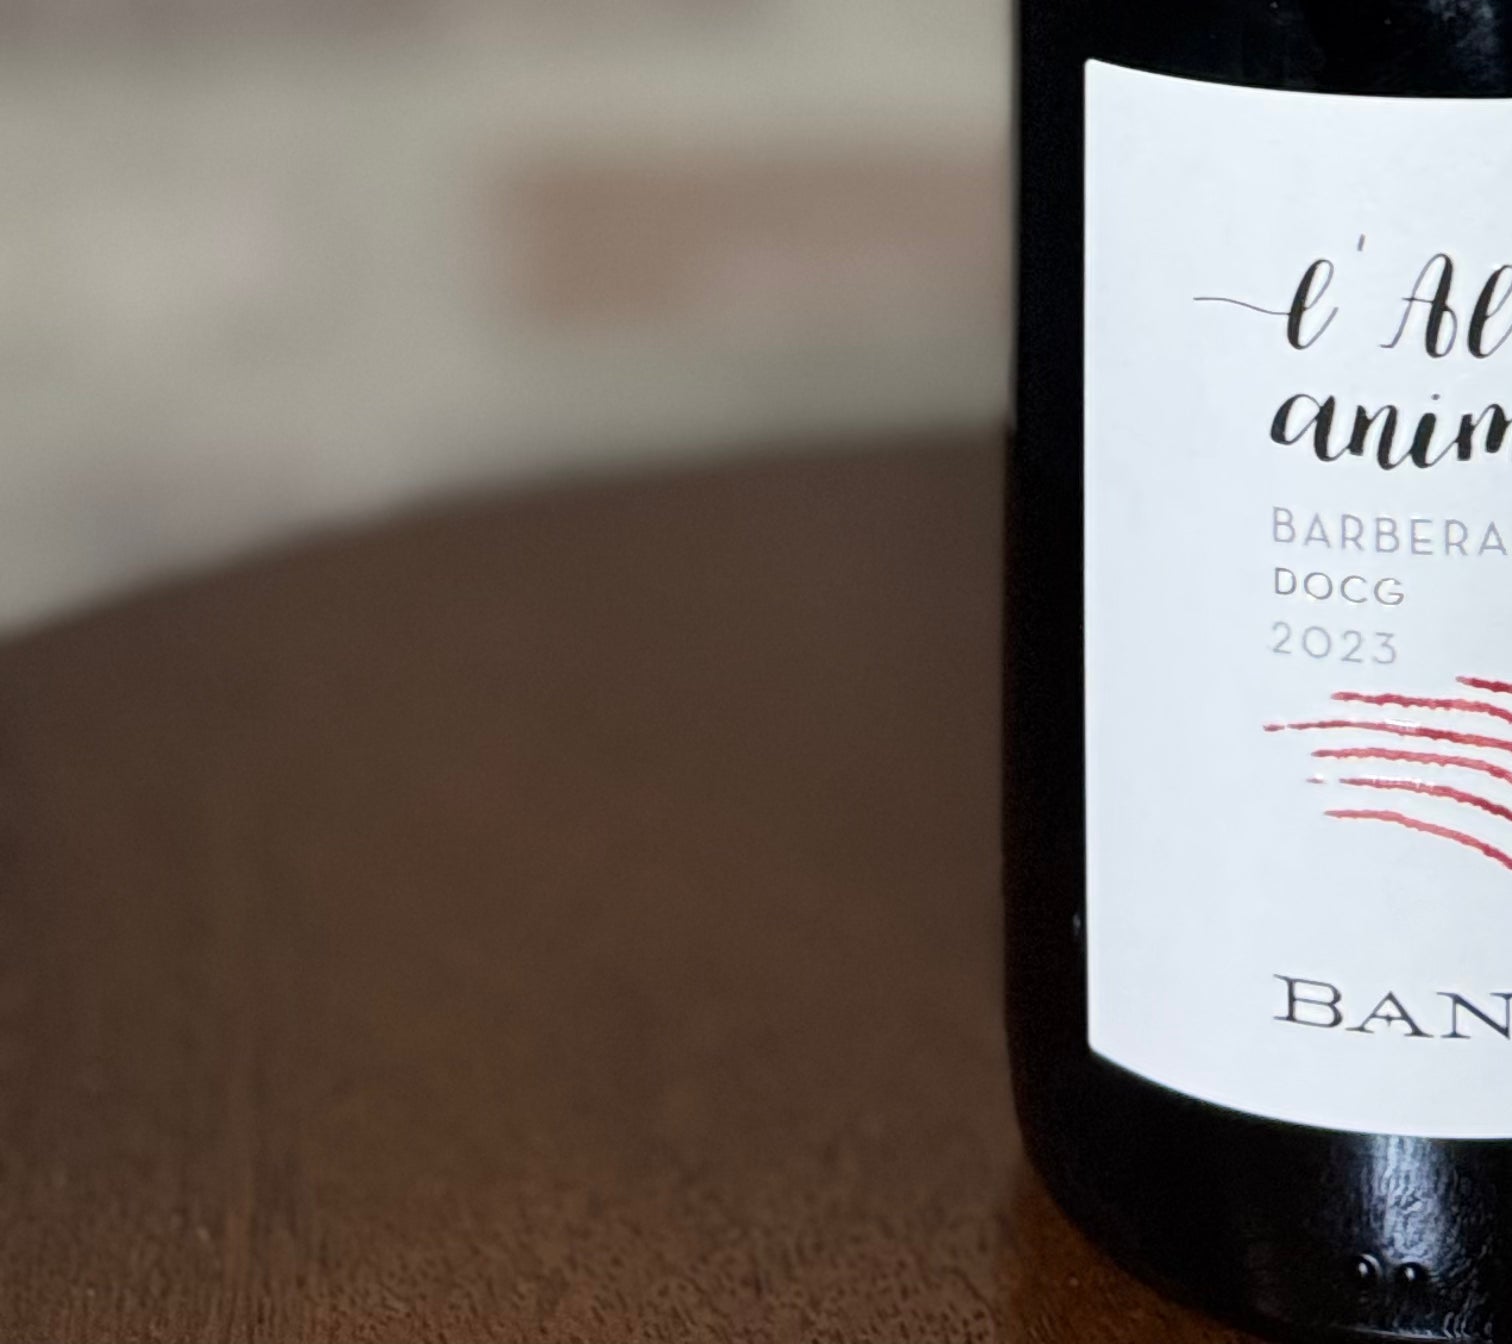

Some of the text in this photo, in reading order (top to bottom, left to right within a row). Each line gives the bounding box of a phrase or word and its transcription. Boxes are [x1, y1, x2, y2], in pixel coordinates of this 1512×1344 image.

[1273, 506, 1508, 556] BARBERA
[1274, 566, 1405, 606] DOCG
[1271, 620, 1398, 665] 2023
